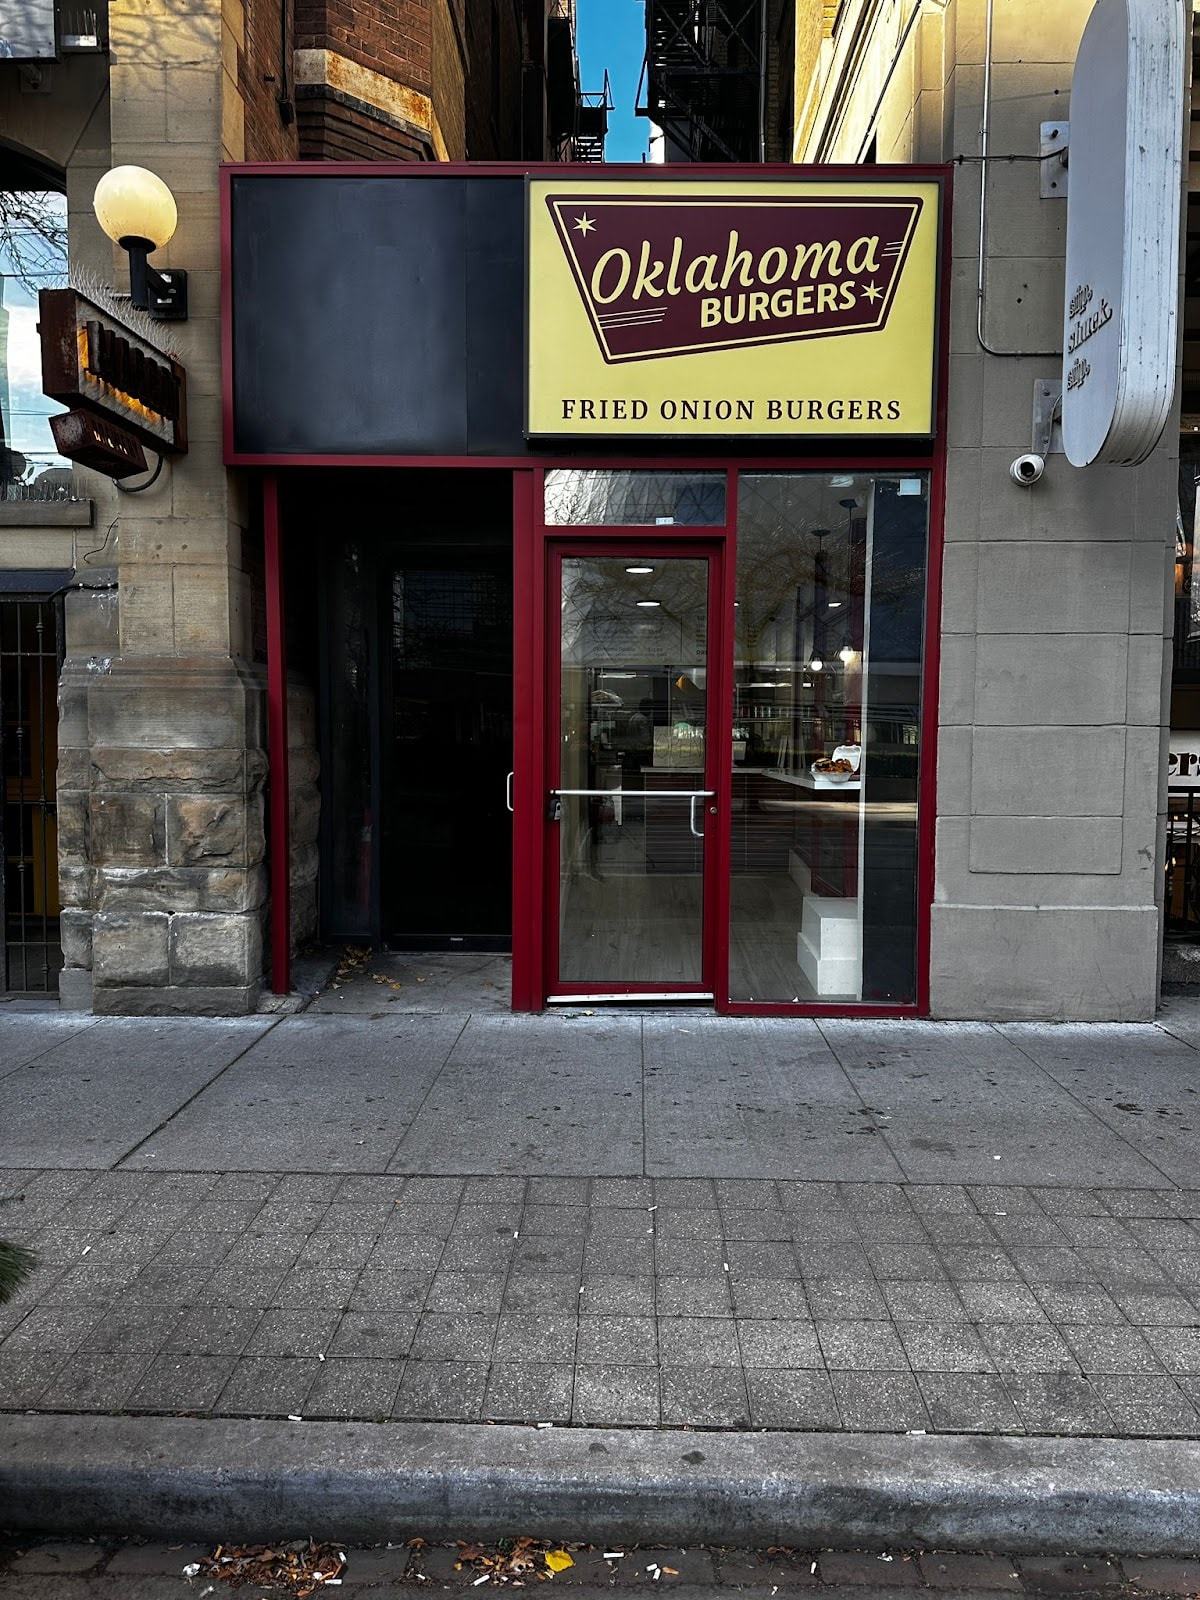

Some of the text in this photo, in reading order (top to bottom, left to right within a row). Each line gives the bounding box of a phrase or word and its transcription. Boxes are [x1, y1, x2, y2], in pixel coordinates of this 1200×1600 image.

[591, 230, 880, 304] Oklahoma
[700, 280, 857, 328] BURGERS
[561, 399, 902, 420] FRIED ONION BURGERS
